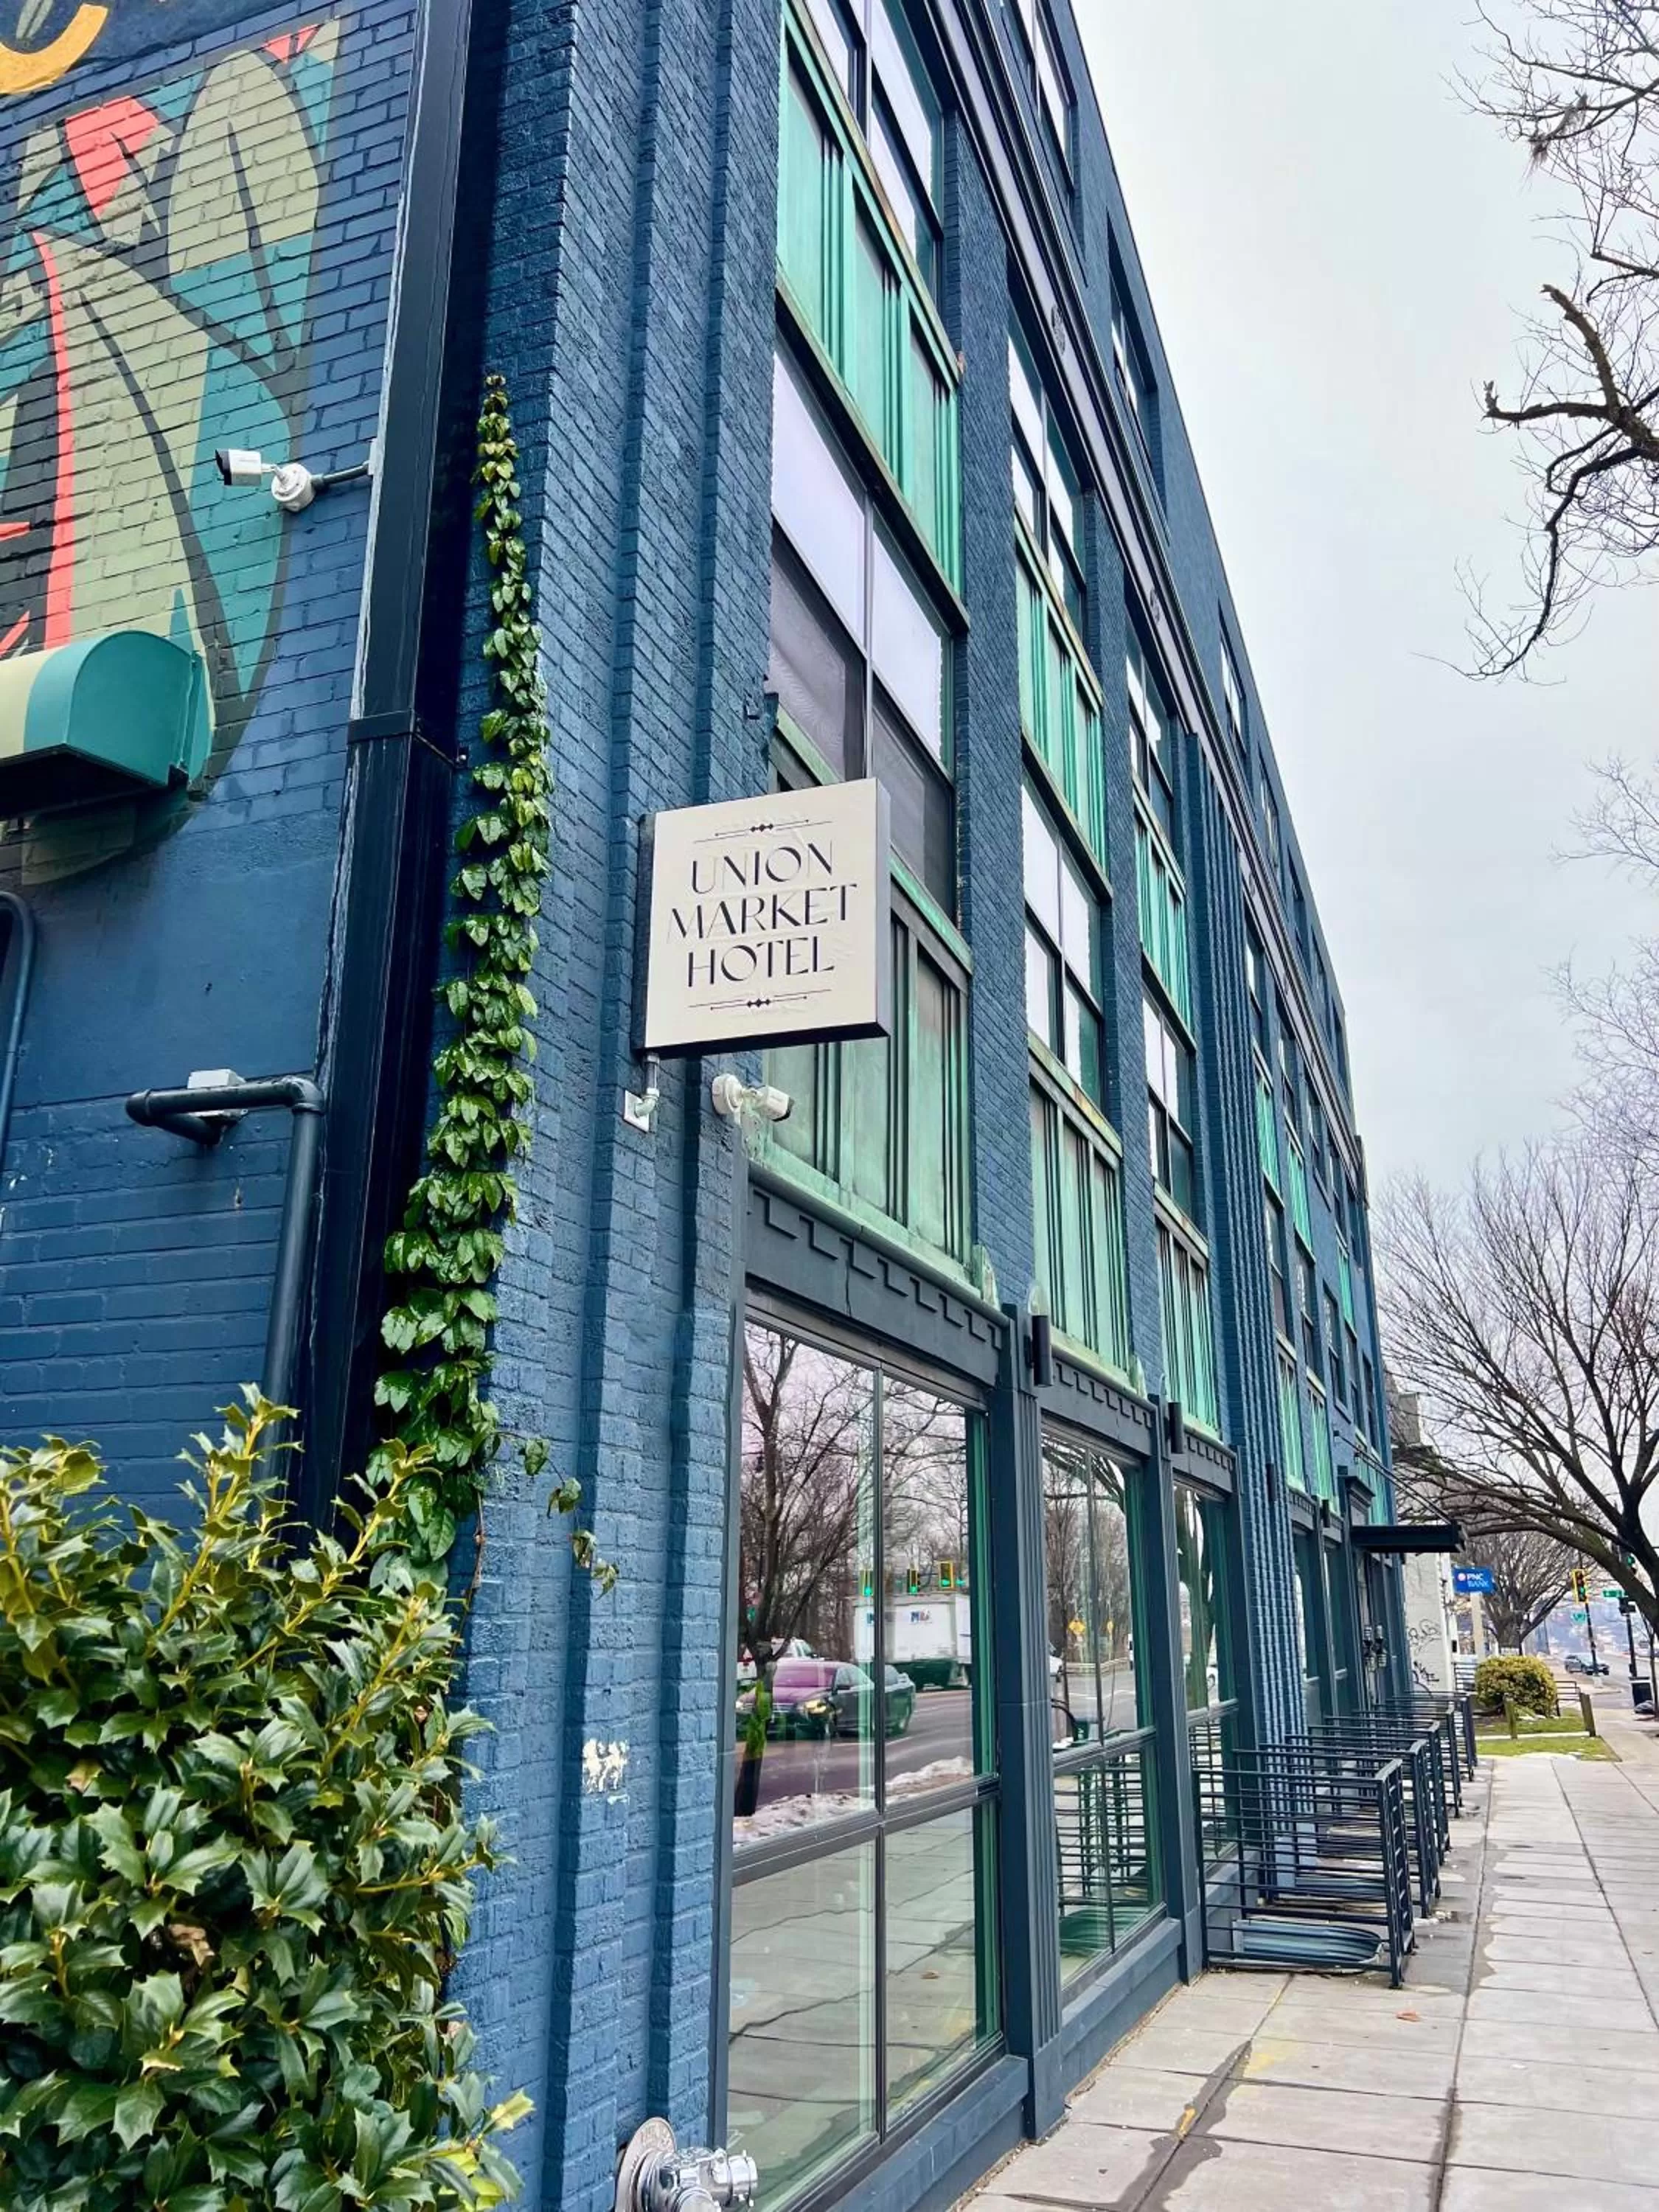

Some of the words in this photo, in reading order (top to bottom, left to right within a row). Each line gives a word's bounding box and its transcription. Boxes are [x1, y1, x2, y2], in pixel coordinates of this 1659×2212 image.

[692, 839, 833, 894] UNION
[667, 883, 858, 944] MARKET
[687, 936, 835, 987] HOTEL
